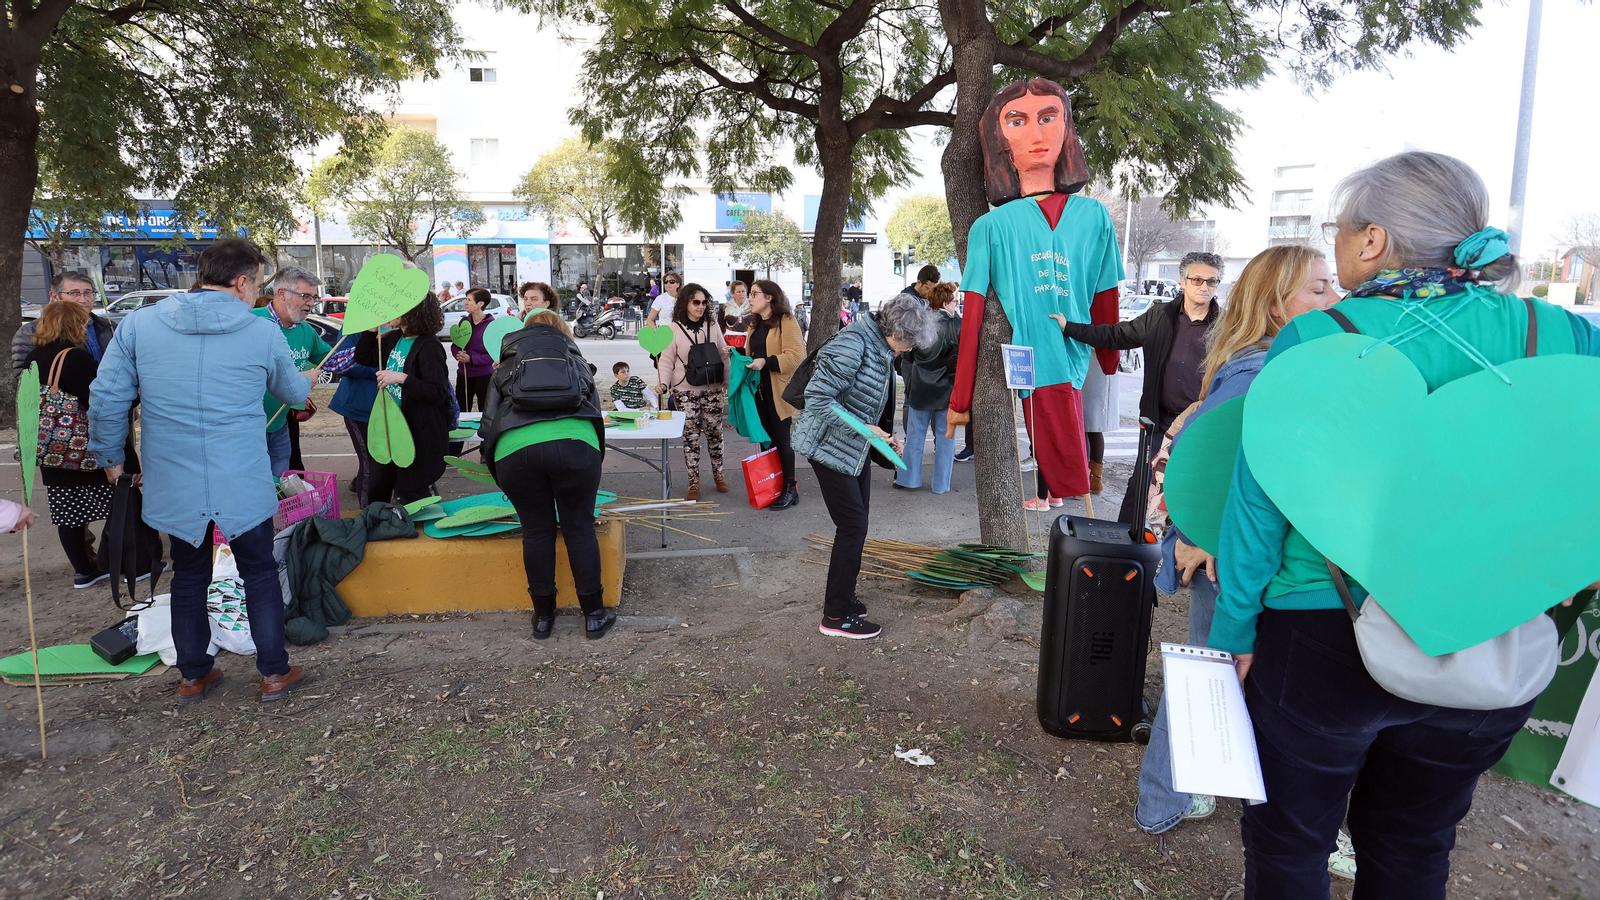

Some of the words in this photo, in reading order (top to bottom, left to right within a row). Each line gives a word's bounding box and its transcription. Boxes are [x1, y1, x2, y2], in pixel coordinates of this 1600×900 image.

[726, 208, 740, 216] CAFÉ
[1038, 269, 1049, 278] DE
[362, 282, 400, 312] Escuela
